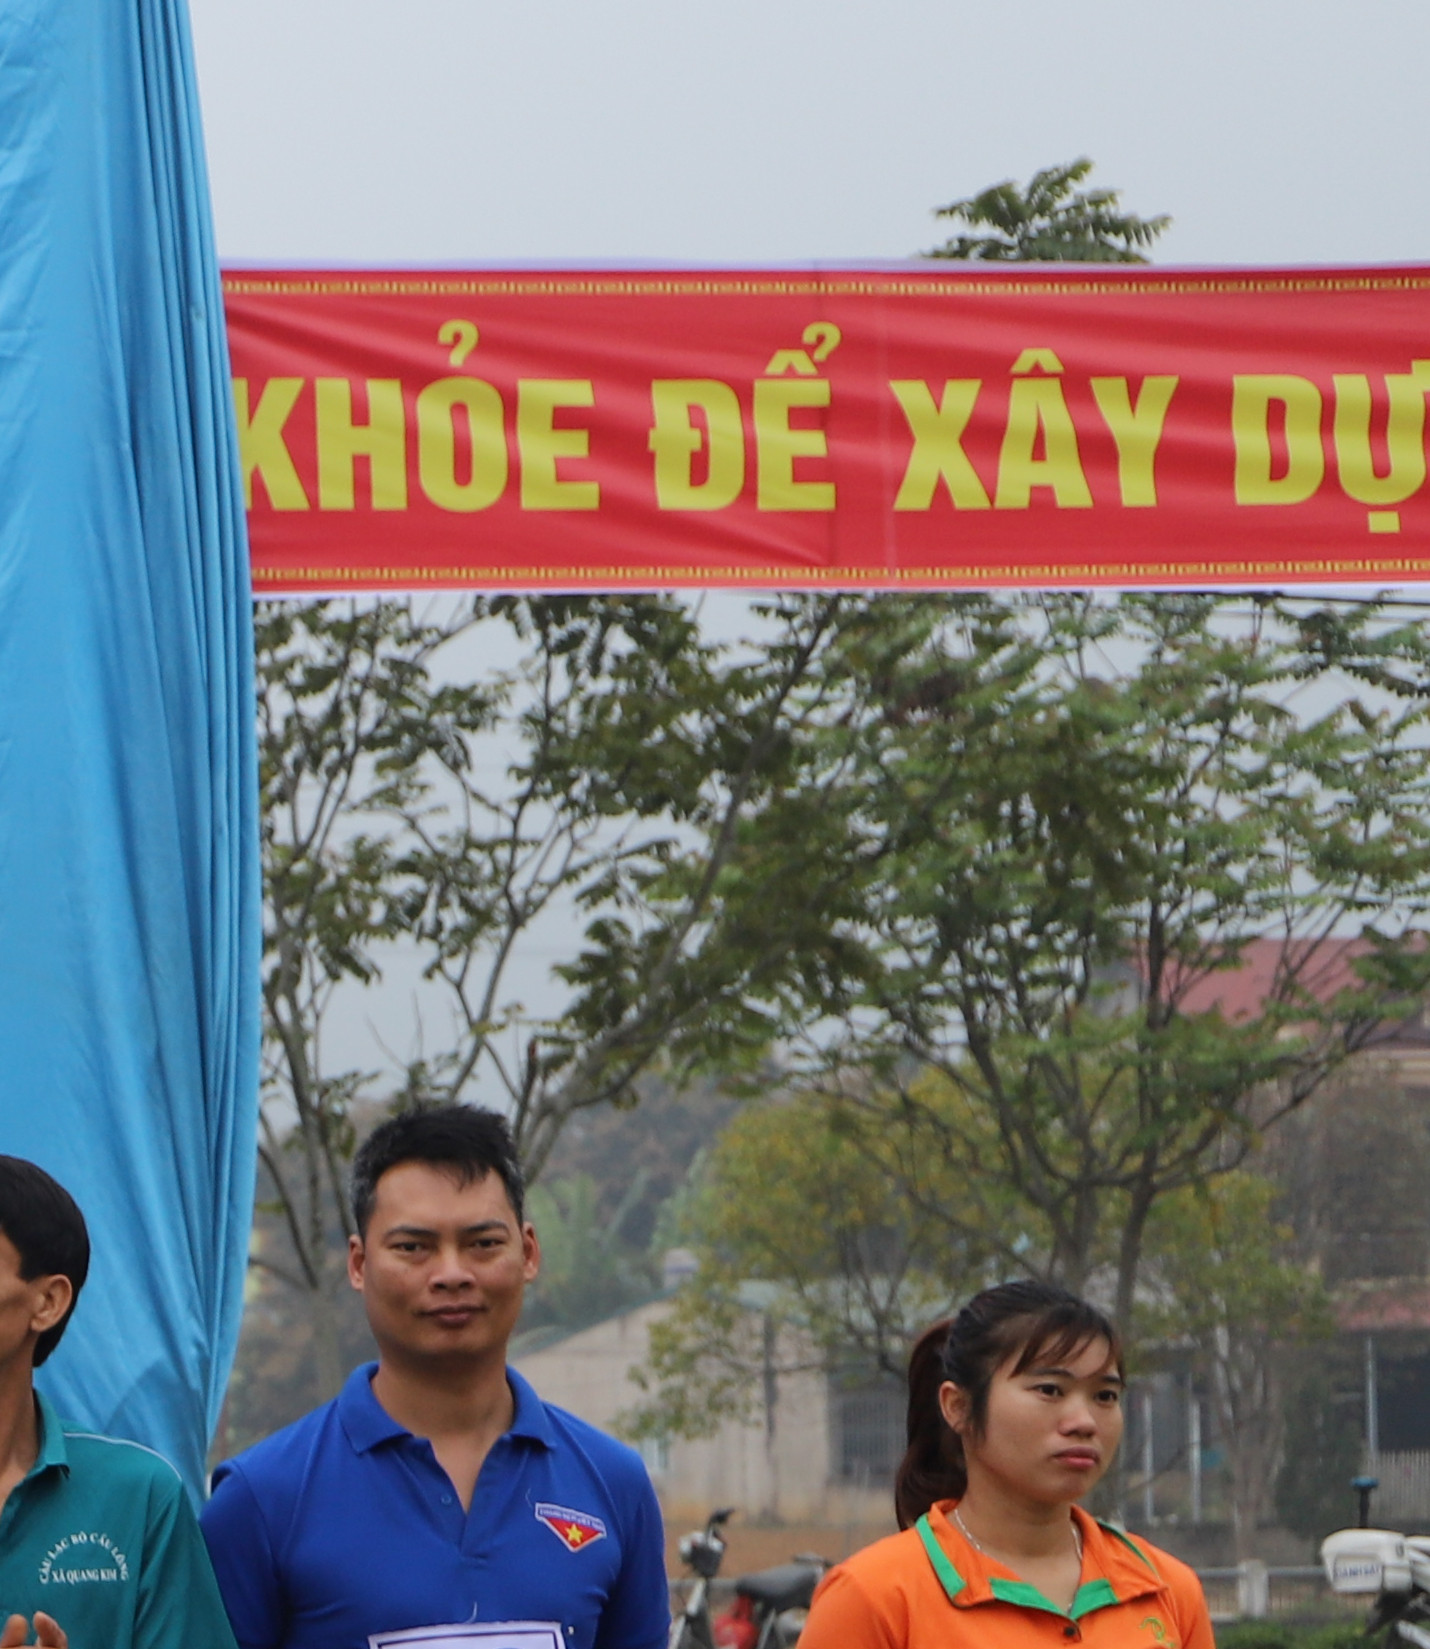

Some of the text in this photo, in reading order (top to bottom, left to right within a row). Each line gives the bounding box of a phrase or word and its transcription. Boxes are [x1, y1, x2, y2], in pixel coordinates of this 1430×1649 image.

[234, 320, 1430, 532] KHỎE ĐỂ XÂY DỰ
